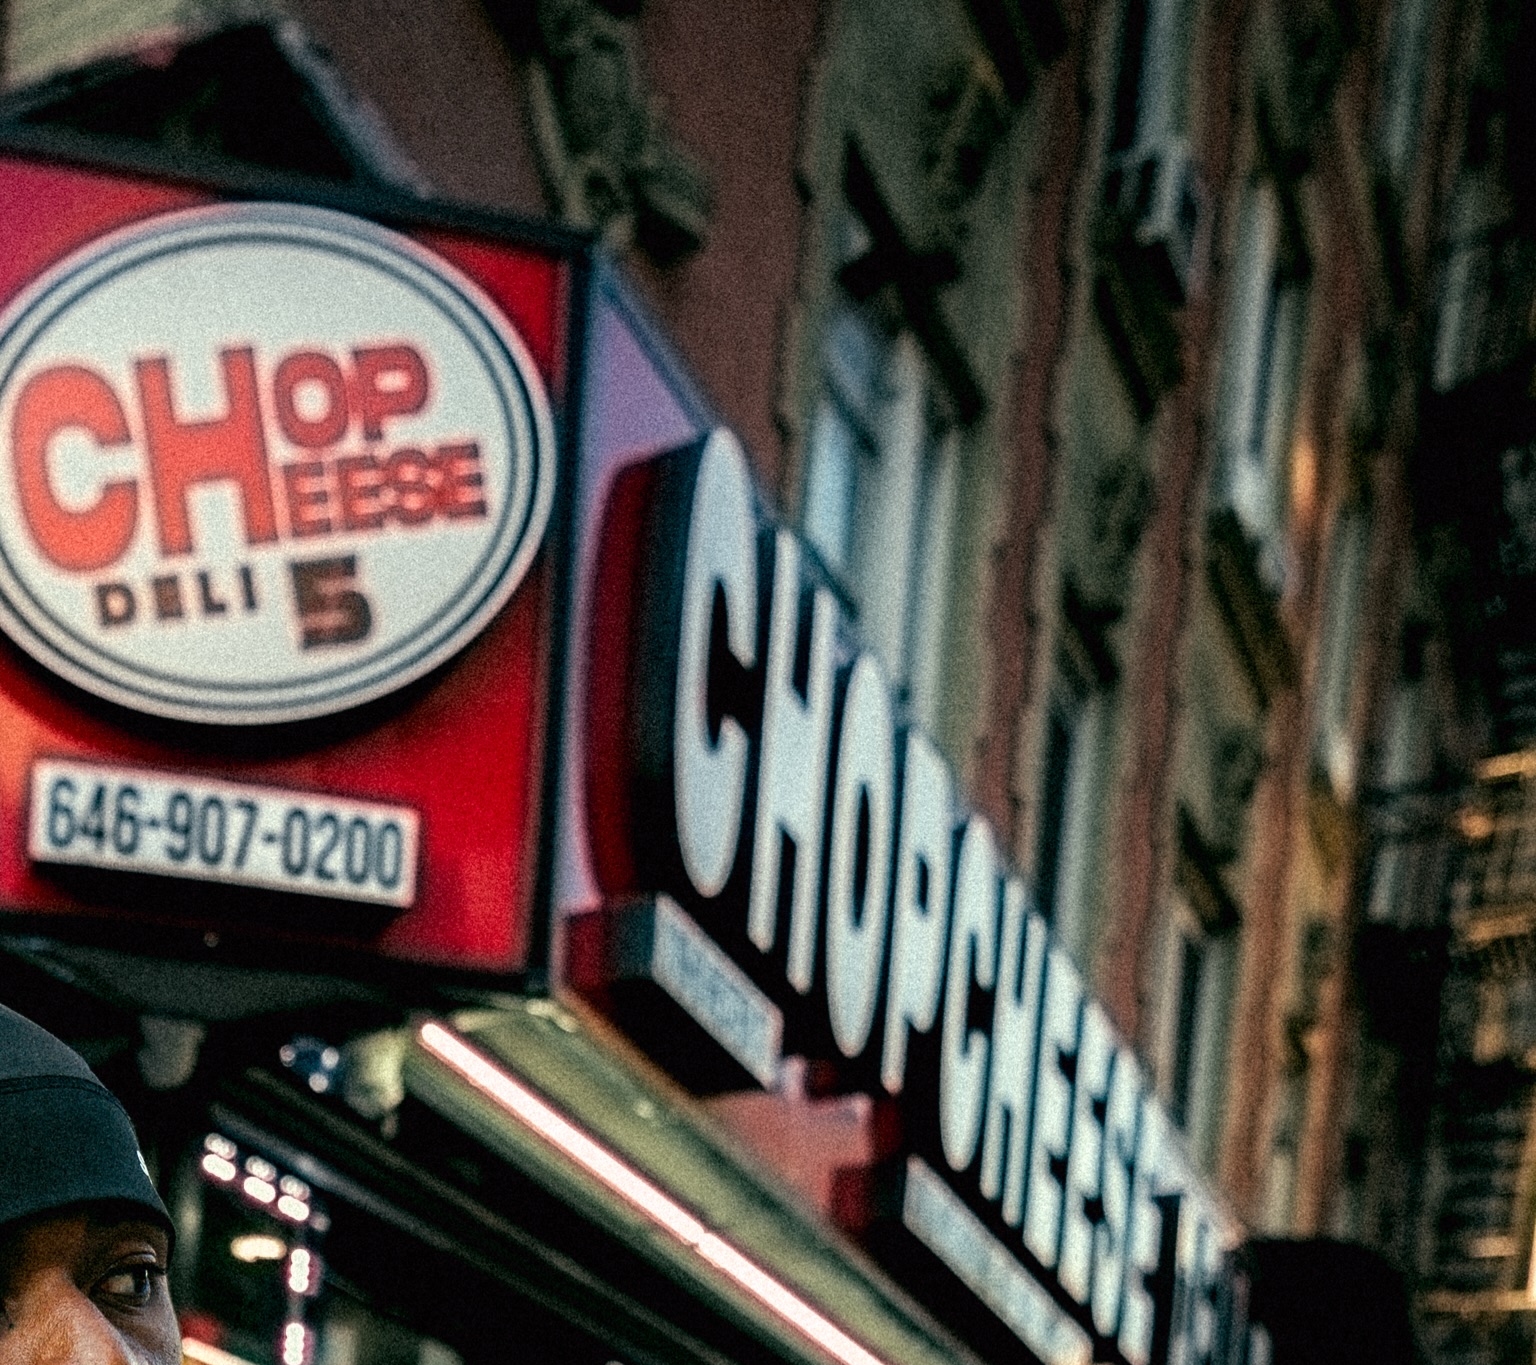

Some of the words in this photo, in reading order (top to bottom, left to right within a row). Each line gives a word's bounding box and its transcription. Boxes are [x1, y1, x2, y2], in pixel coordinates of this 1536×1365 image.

[96, 566, 258, 627] DELI
[290, 556, 373, 651] 5
[46, 779, 403, 888] 646-907-0200
